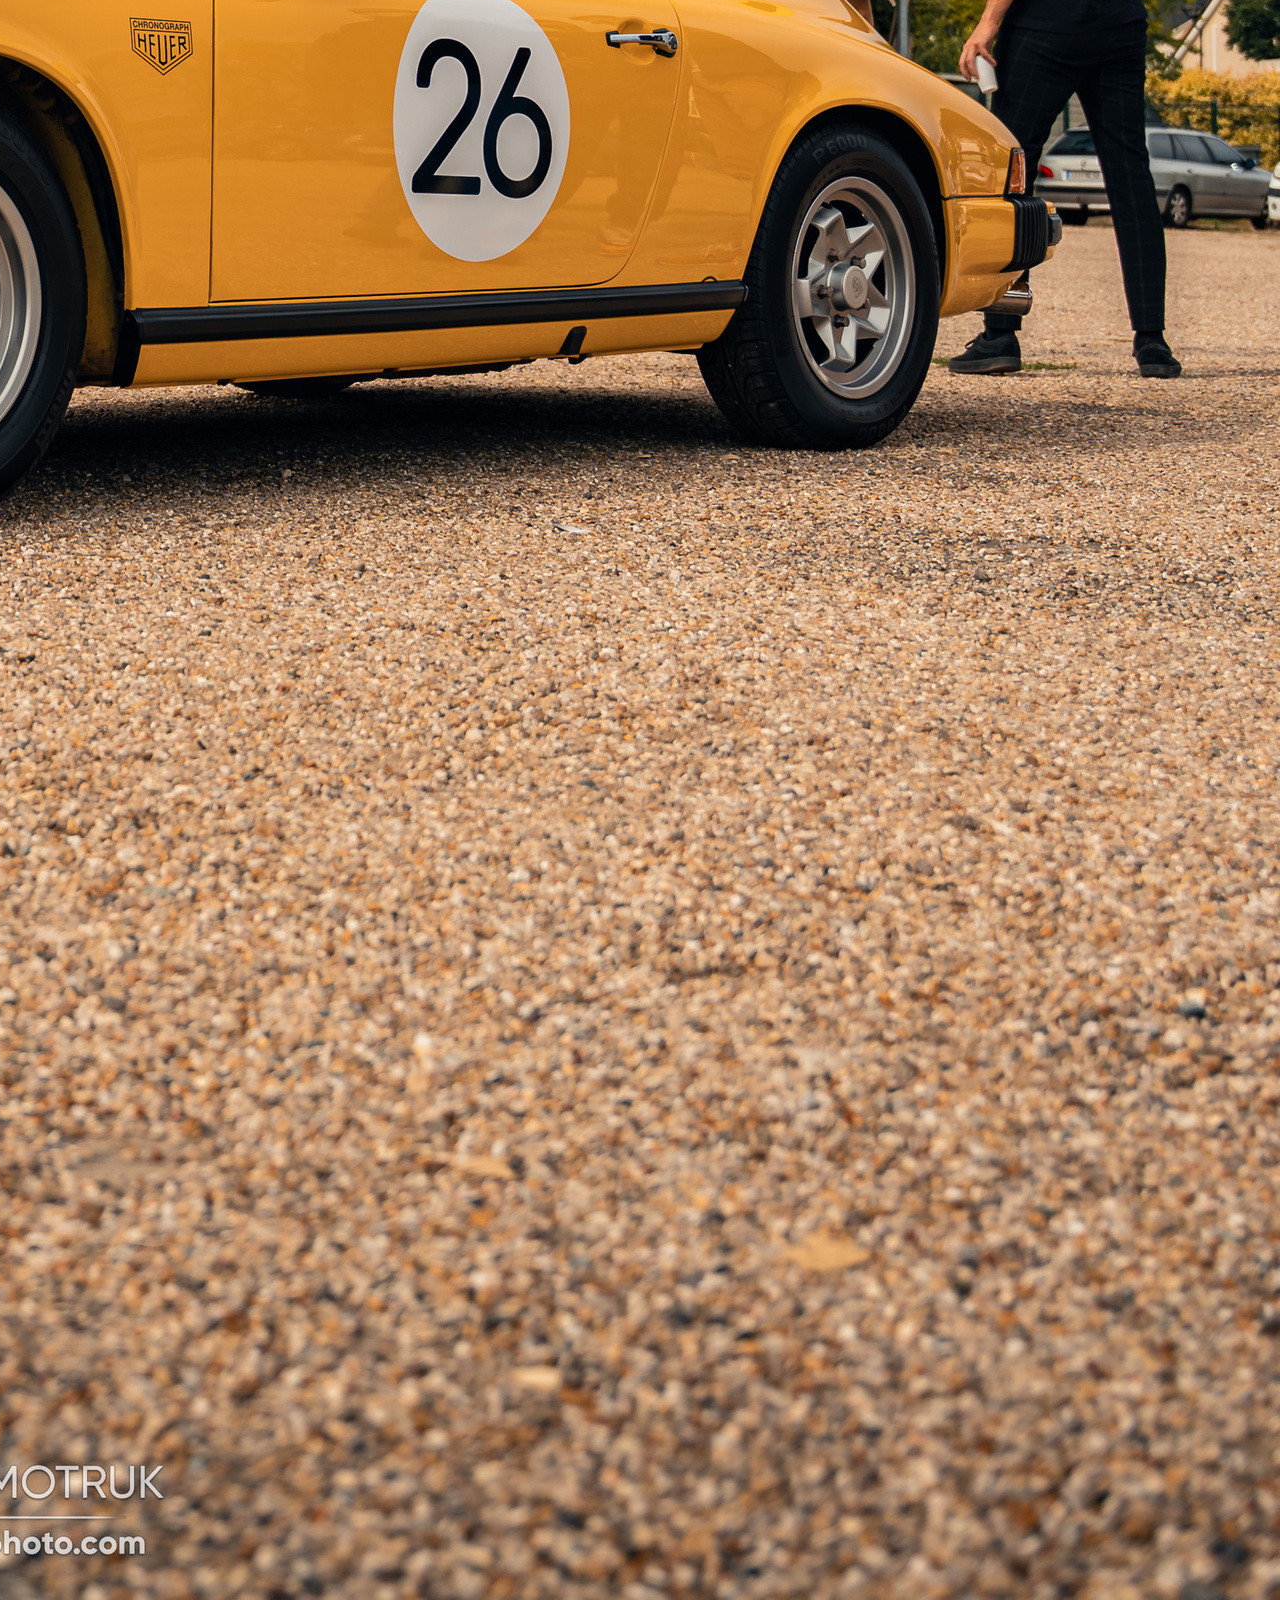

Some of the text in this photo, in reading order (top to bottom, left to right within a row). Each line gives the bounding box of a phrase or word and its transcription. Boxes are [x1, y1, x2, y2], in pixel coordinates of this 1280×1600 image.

[132, 20, 189, 31] CHRONOGRAPH
[137, 33, 187, 66] HEUER
[411, 37, 552, 199] 26
[812, 134, 867, 165] P6000
